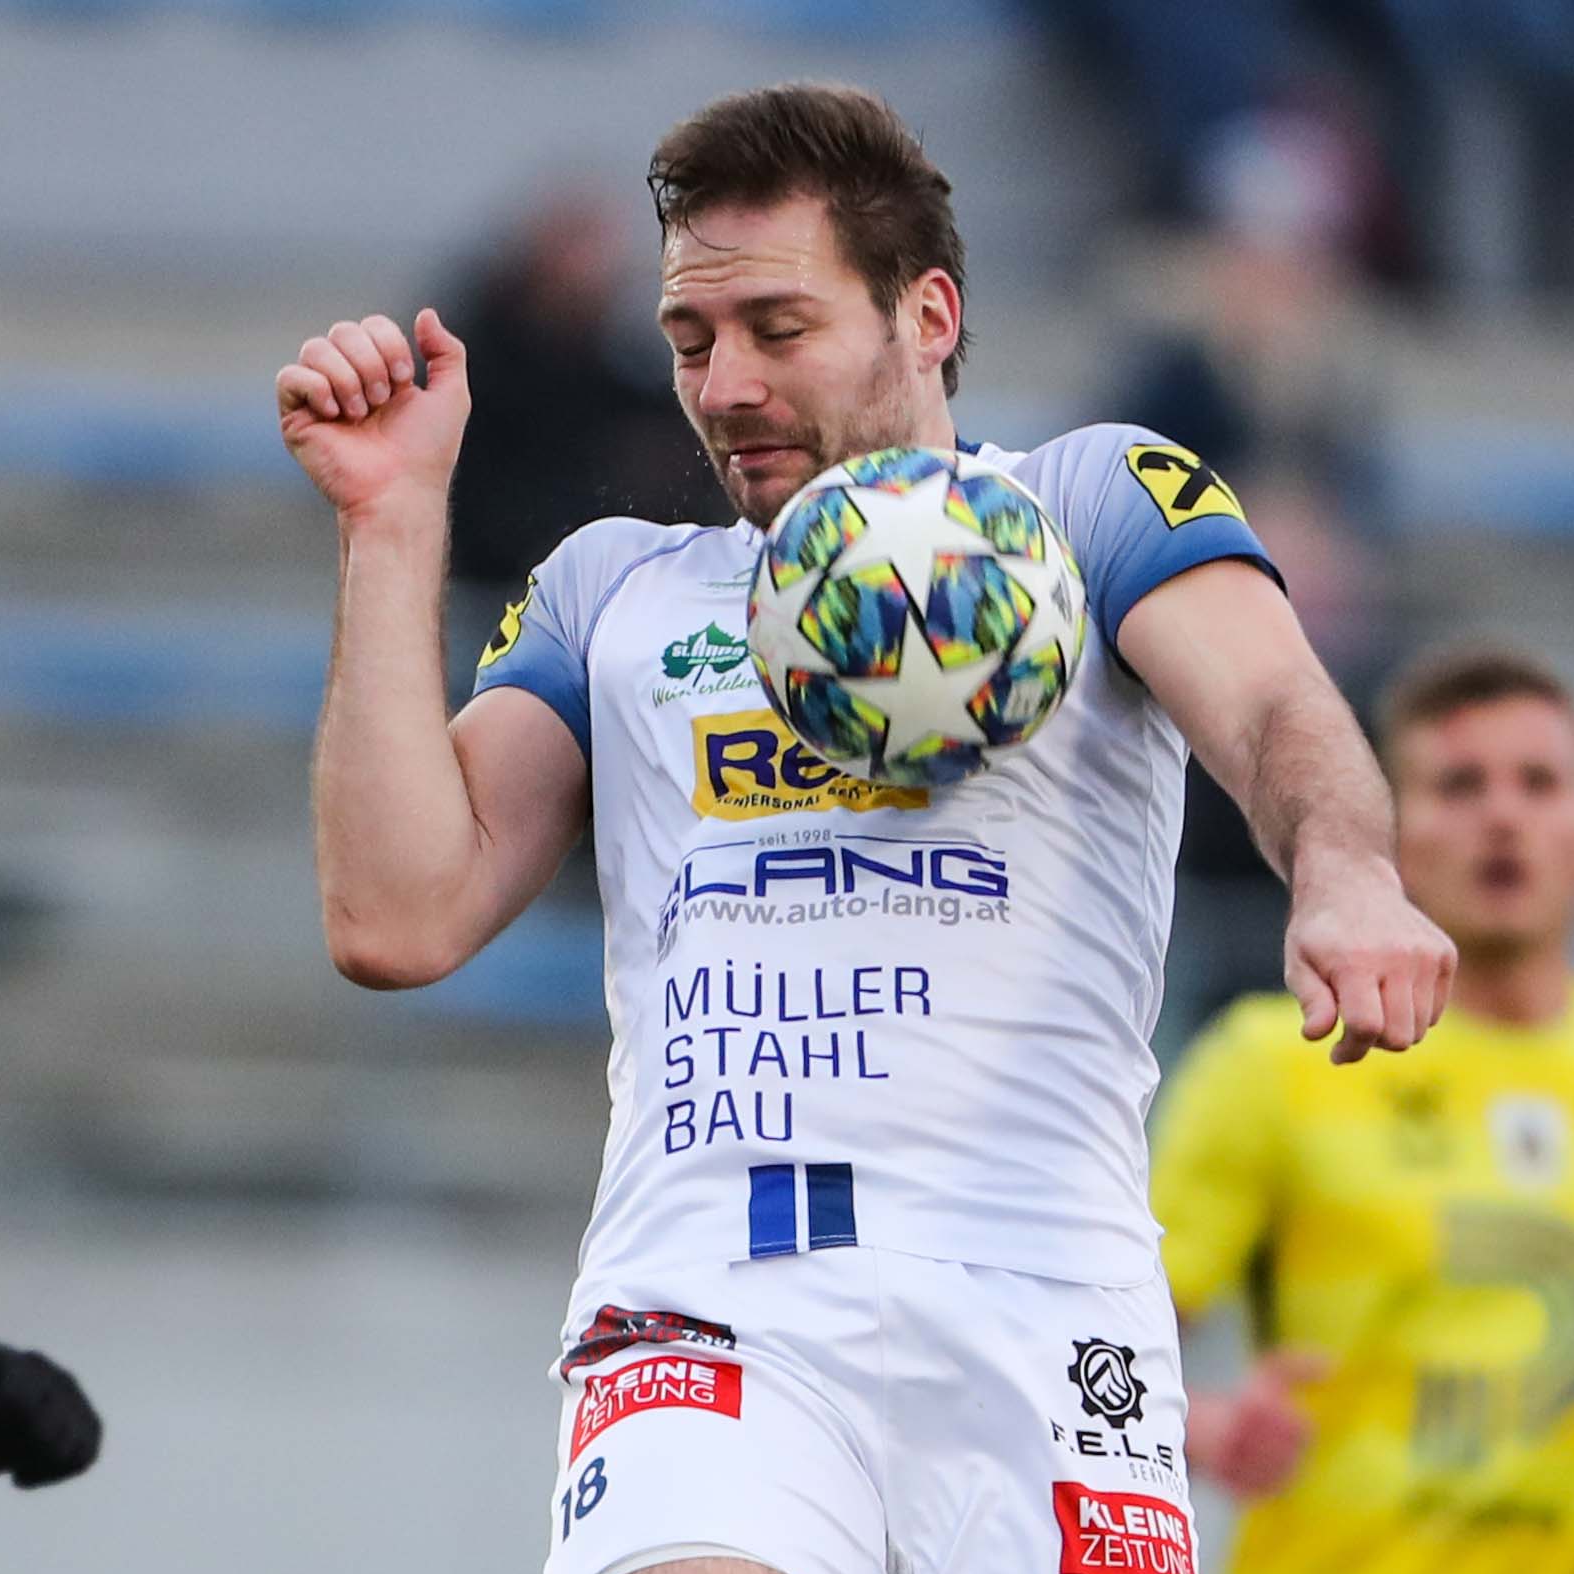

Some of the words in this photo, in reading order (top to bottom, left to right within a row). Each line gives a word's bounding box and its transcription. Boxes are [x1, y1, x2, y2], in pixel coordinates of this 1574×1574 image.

[684, 847, 1009, 899] LANG
[683, 888, 1012, 926] www.auto-lang.at
[664, 959, 932, 1030] MÜLLER
[664, 1027, 891, 1090] STAHL
[664, 1089, 793, 1156] BAU
[578, 1384, 716, 1447] ZEITUNG
[581, 1360, 717, 1421] KLEINE
[560, 1457, 608, 1543] 18
[1078, 1496, 1187, 1550] KLEINE
